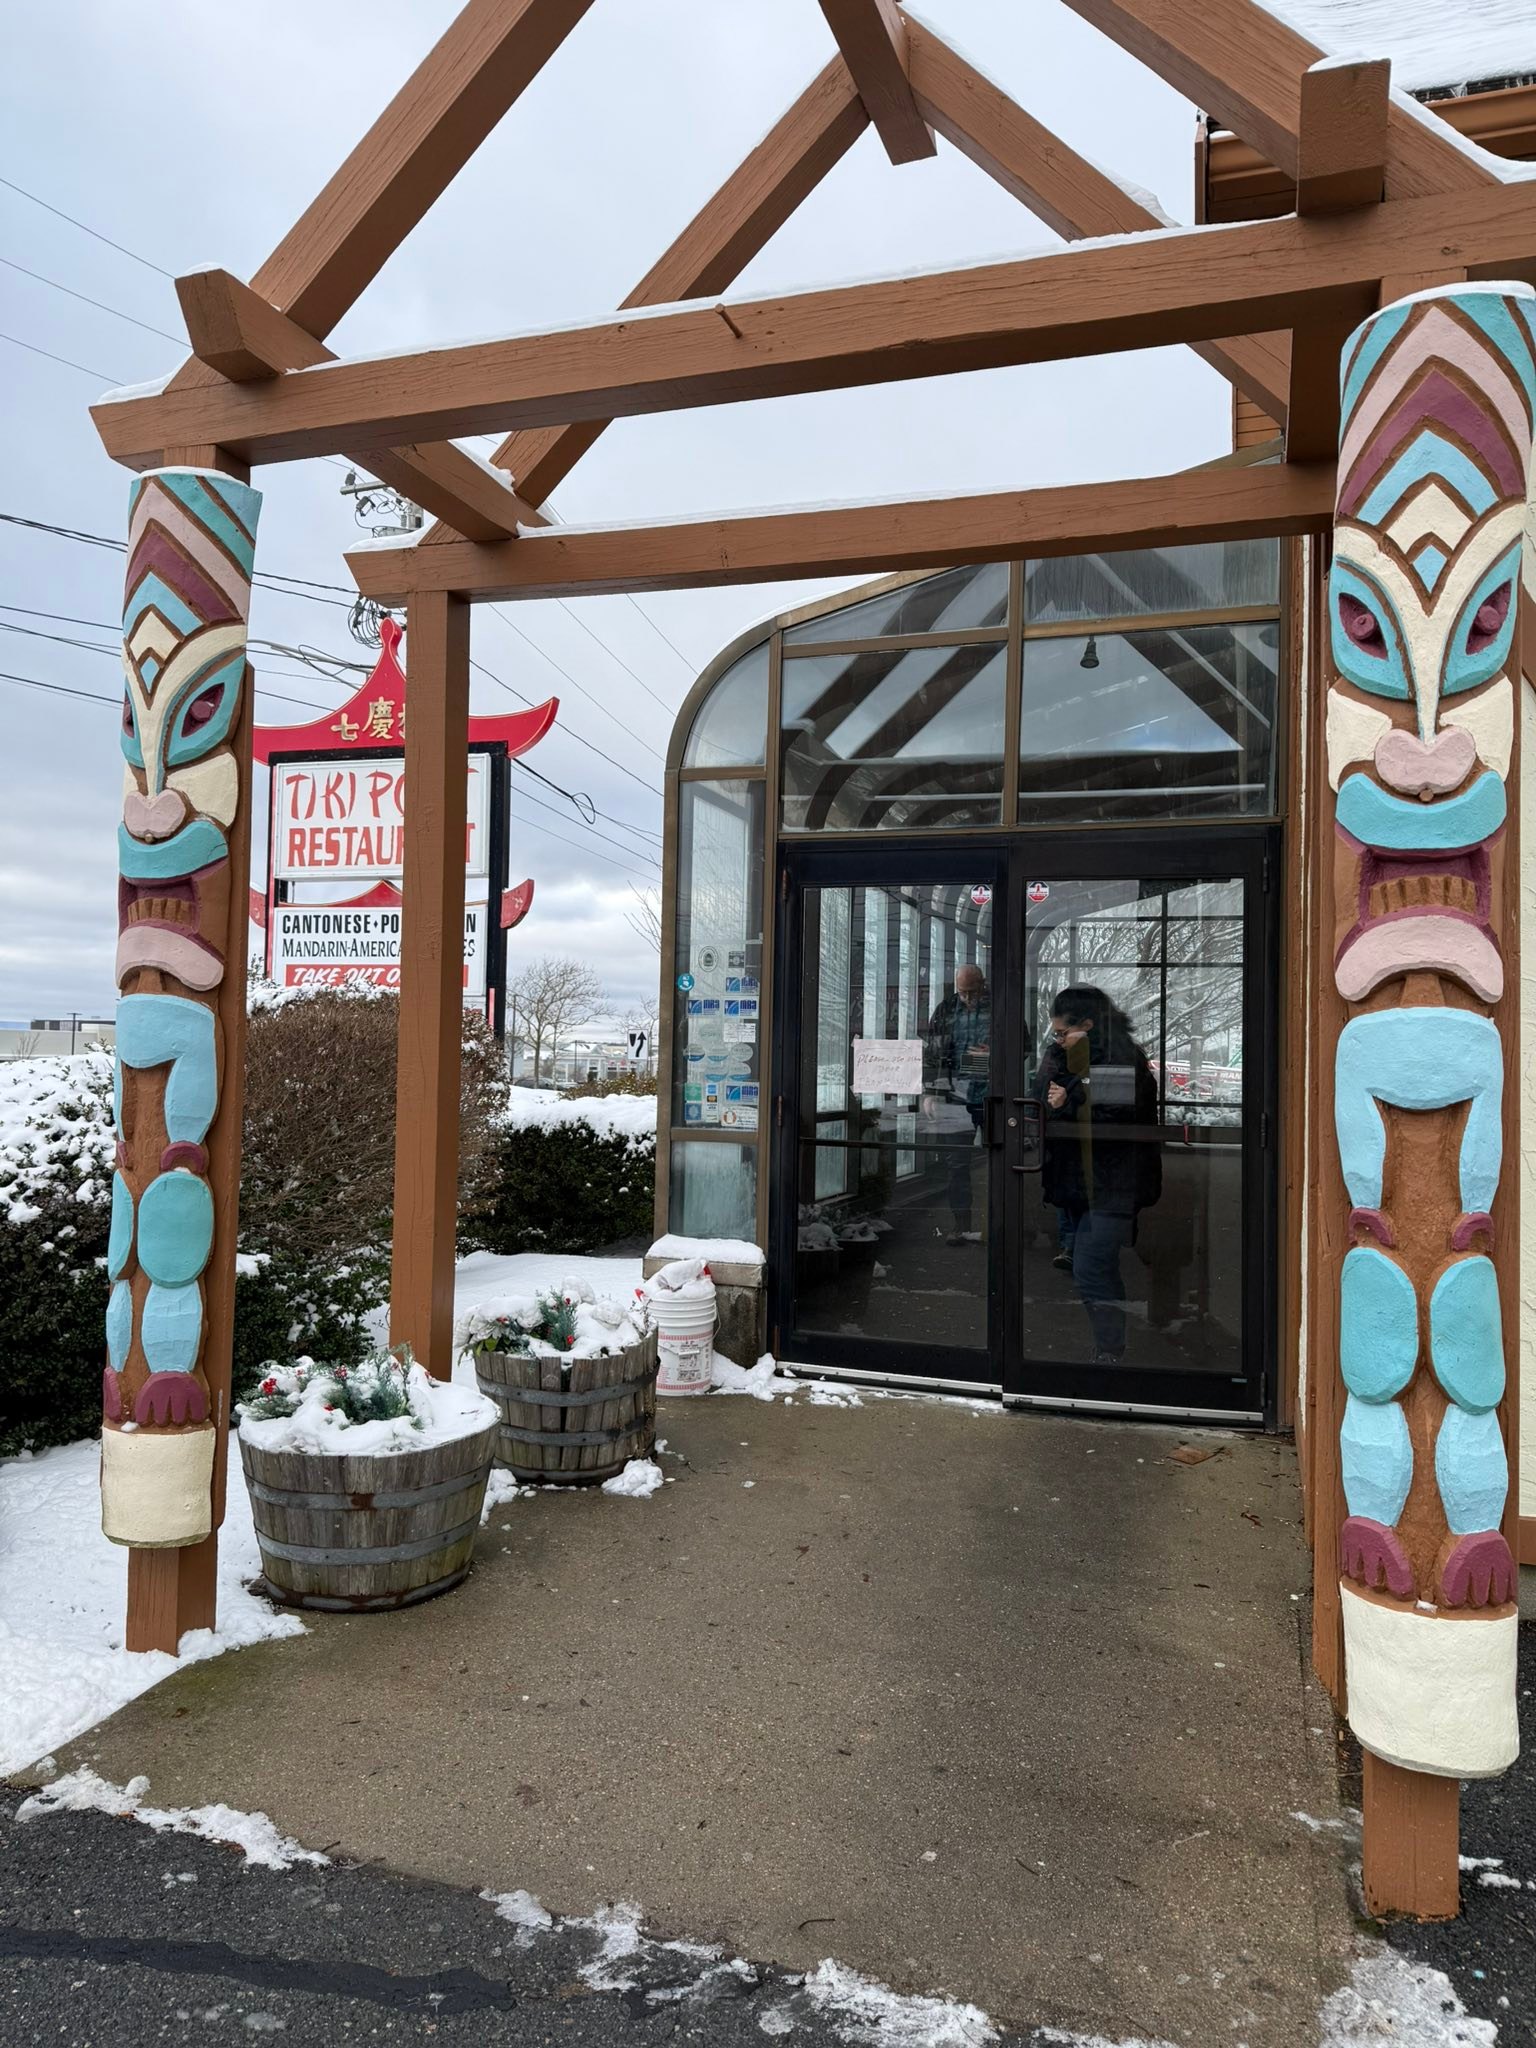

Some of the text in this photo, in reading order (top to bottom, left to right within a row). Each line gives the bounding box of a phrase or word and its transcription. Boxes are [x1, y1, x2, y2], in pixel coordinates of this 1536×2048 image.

[285, 771, 356, 821] TIKI
[282, 914, 371, 934] CANTONESE
[282, 938, 401, 957] MANDARIN-AMERIC
[294, 967, 341, 984] TAKE
